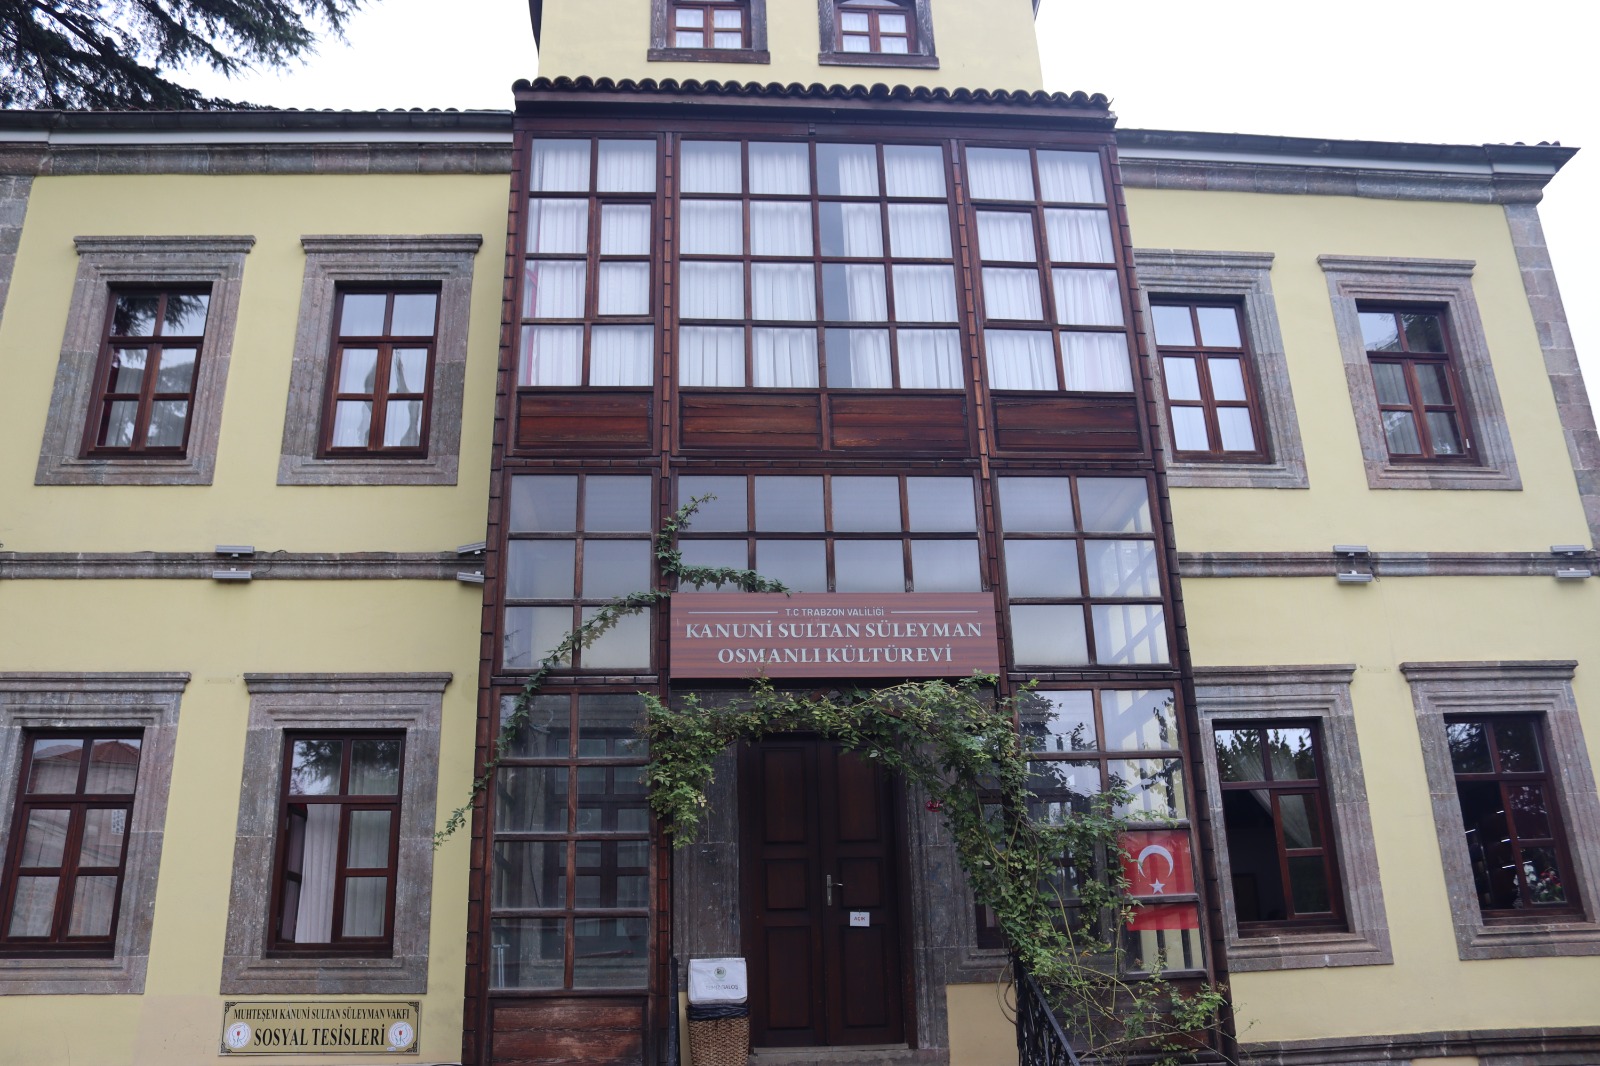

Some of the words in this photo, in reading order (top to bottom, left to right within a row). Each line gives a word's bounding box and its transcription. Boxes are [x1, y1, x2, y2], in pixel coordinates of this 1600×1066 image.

[801, 607, 845, 617] TRABZON
[847, 606, 885, 617] VALİLİĞİ
[685, 620, 773, 638] KANUNİ
[778, 622, 860, 638] SULTAN
[865, 620, 982, 638] SÜLEYMAN
[718, 648, 824, 663] OSMANLI
[234, 1008, 278, 1021] MUHTEŞEM
[280, 1007, 310, 1020] KANUNİ
[311, 1008, 341, 1020] SULTAN
[342, 1006, 385, 1020] SÜLEYMAN
[387, 1008, 409, 1020] VAKFI
[254, 1028, 308, 1046] SOSYAL
[312, 1023, 385, 1046] TESİSLERİ
